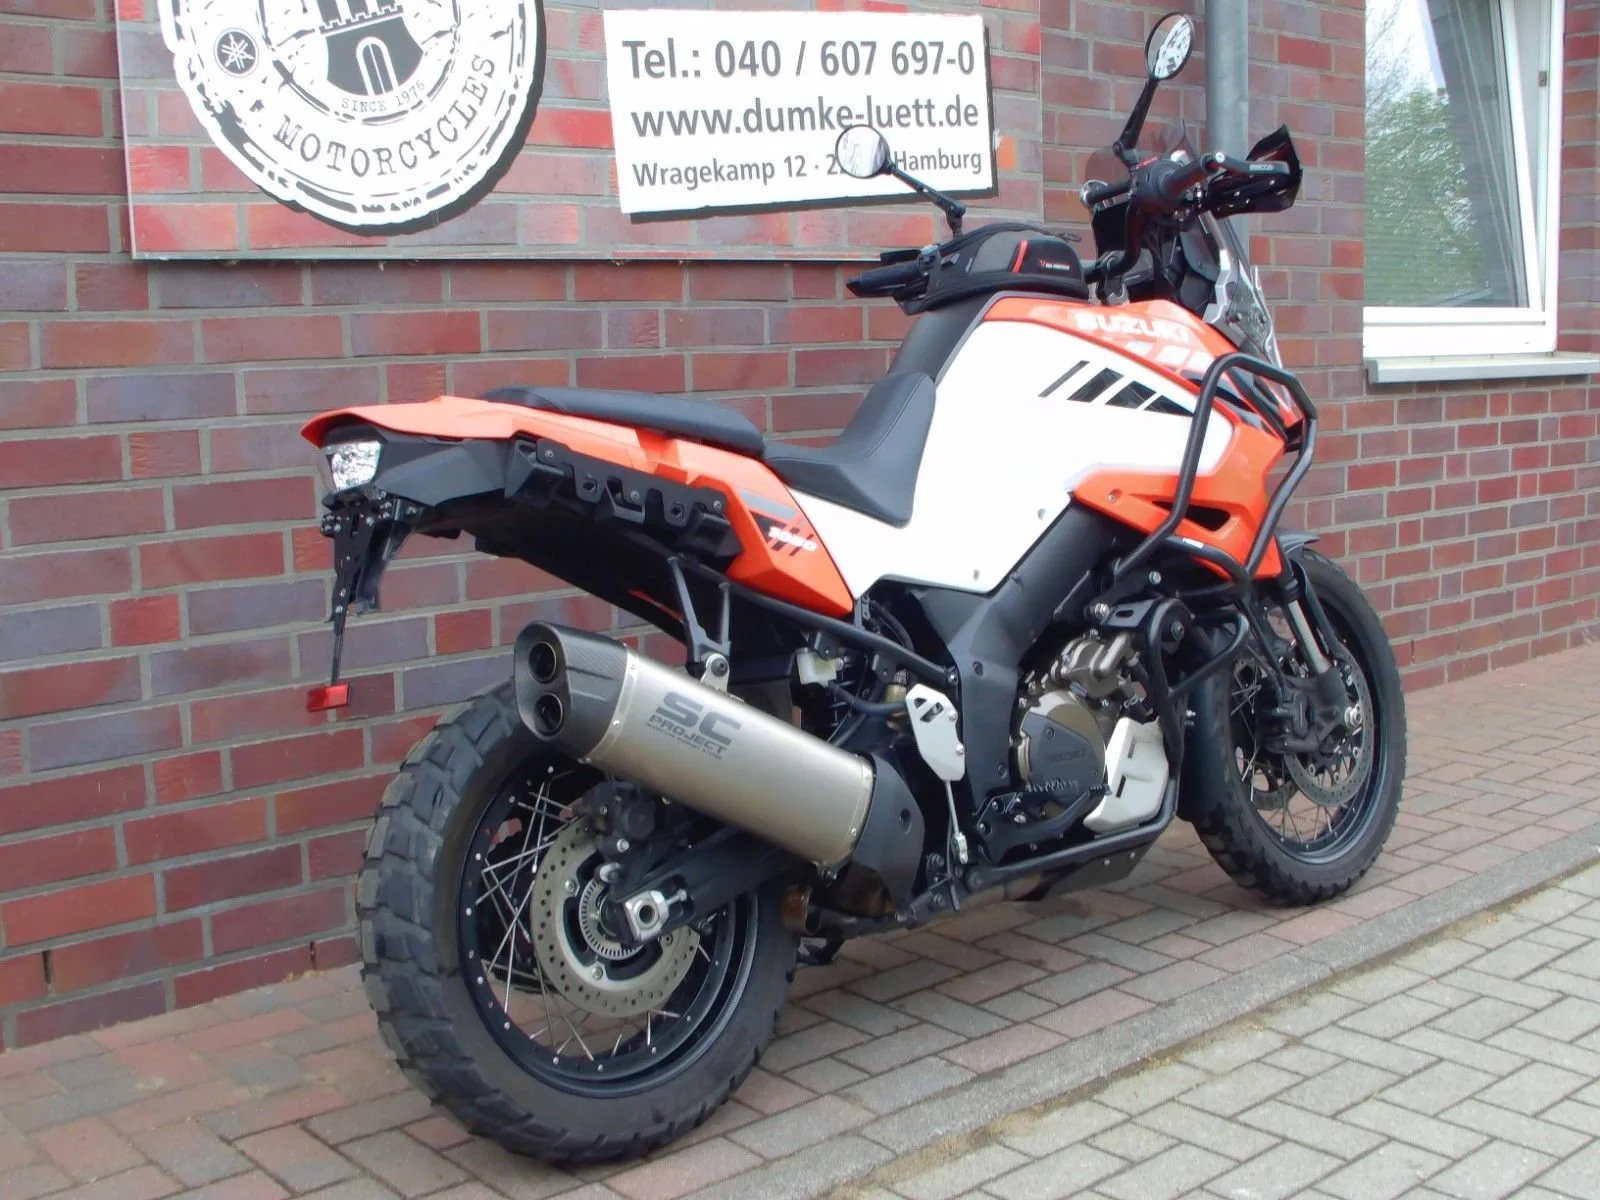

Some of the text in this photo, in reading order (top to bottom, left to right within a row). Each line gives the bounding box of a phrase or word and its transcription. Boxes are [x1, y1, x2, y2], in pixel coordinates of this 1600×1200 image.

[621, 37, 975, 79] Tel.: 040 / 607 697-0
[272, 53, 496, 179] MOTORCYCLES
[341, 79, 425, 112] SINCE 1976
[630, 94, 979, 138] www.dumke-luett.de
[631, 157, 776, 191] Wragekamp
[783, 155, 808, 178] 12
[893, 147, 982, 175] Hamburg
[1074, 311, 1191, 344] SUZUKI
[649, 714, 728, 755] PROJECT
[655, 691, 742, 746] SC
